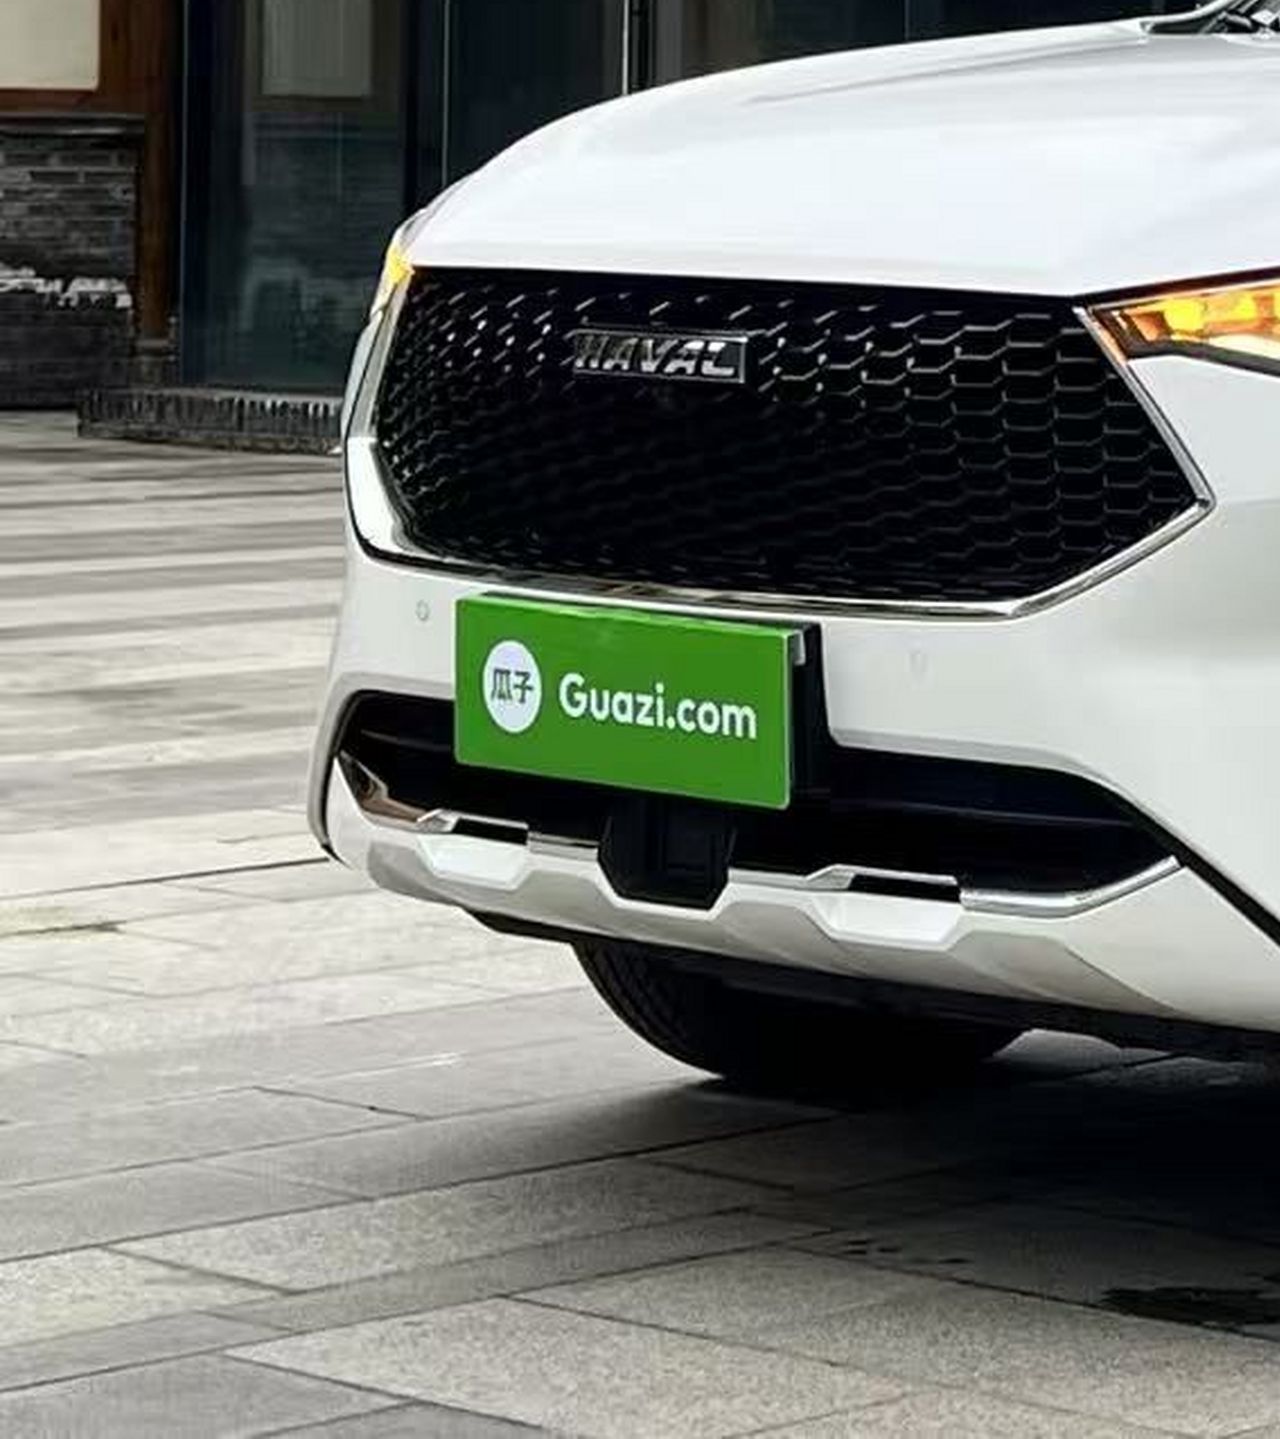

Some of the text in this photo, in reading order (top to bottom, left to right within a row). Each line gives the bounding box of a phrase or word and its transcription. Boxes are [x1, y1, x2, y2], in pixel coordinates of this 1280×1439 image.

[573, 335, 735, 377] HAVAL
[490, 668, 534, 705] 瓜子
[558, 672, 758, 739] Guazi.com
